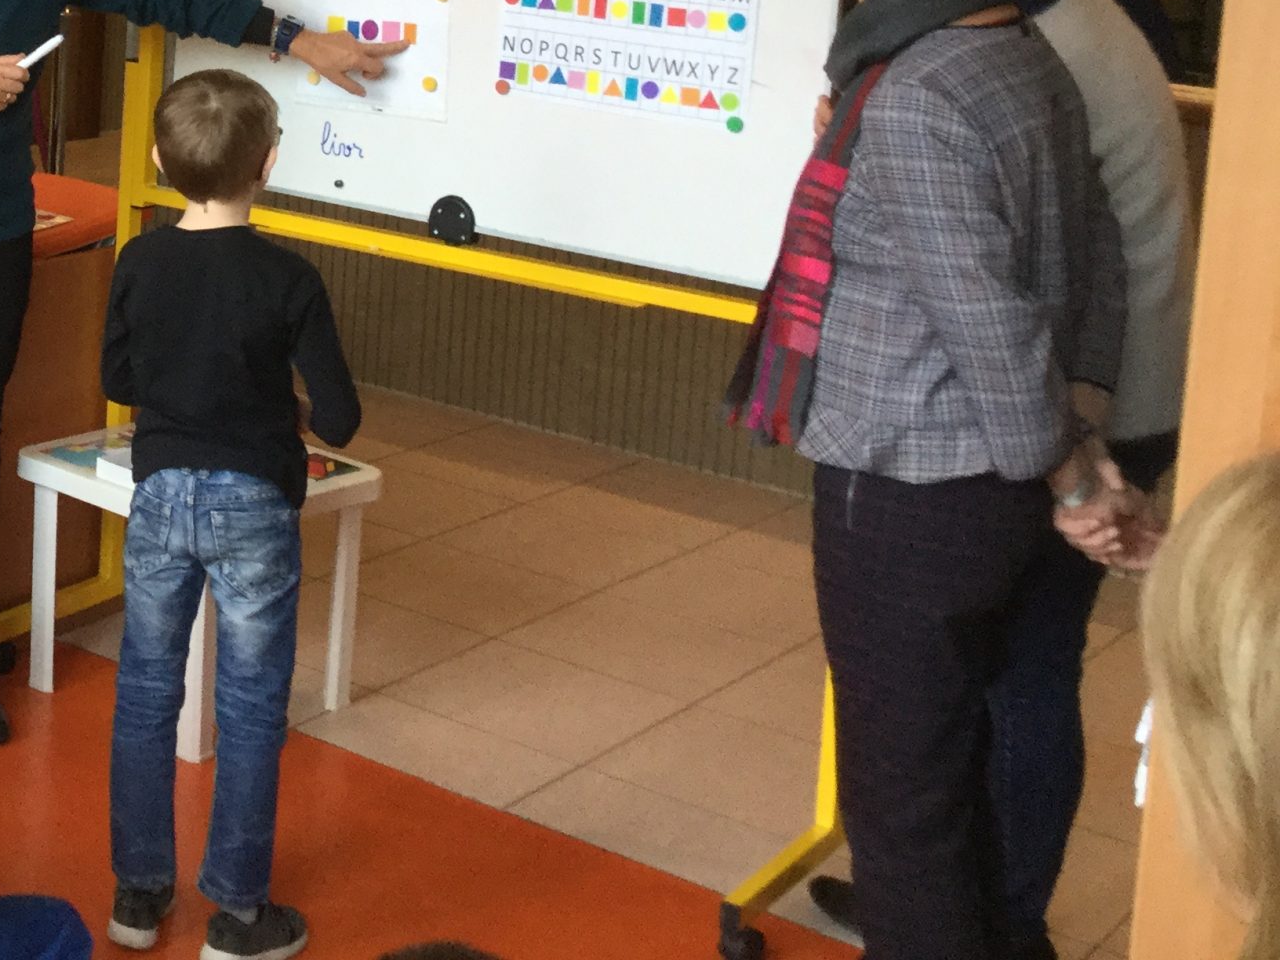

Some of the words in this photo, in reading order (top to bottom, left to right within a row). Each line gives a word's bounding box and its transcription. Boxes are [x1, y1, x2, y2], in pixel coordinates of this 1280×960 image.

[502, 35, 516, 51] N
[520, 38, 533, 54] O
[539, 40, 550, 55] P
[554, 42, 569, 62] Q
[574, 45, 585, 62] R
[592, 48, 602, 64] S
[611, 50, 622, 66] T
[628, 53, 641, 70] U
[647, 56, 660, 72] V
[663, 57, 684, 76] W
[687, 61, 698, 78] X
[708, 64, 719, 80] Y
[727, 67, 739, 84] Z
